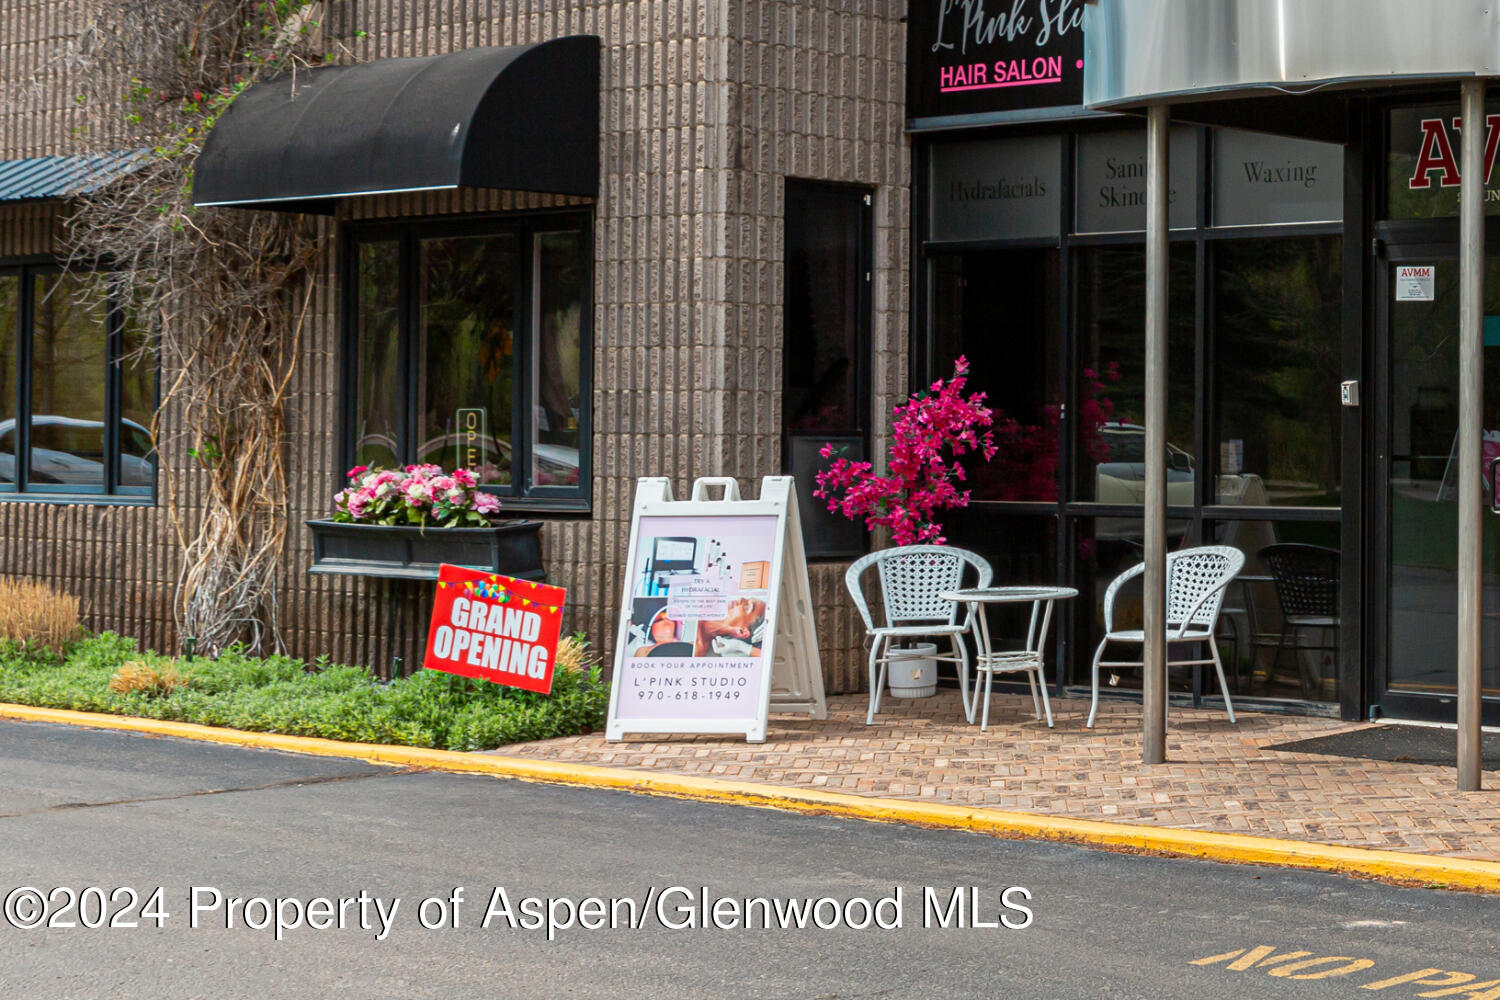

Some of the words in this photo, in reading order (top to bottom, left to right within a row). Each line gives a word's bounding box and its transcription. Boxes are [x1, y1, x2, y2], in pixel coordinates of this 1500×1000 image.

[940, 63, 987, 87] HAIR
[994, 55, 1063, 83] SALON
[949, 174, 1047, 202] Hydrafacials
[1242, 160, 1318, 188] Waxing
[1401, 267, 1430, 277] AVMM
[465, 411, 478, 470] OPE
[451, 597, 541, 642] GRAND
[433, 625, 548, 680] OPENING
[634, 677, 683, 687] L'PINK
[691, 677, 747, 687] STUDIO
[638, 691, 740, 701] 970-618-1949
[1187, 944, 1377, 980] NO
